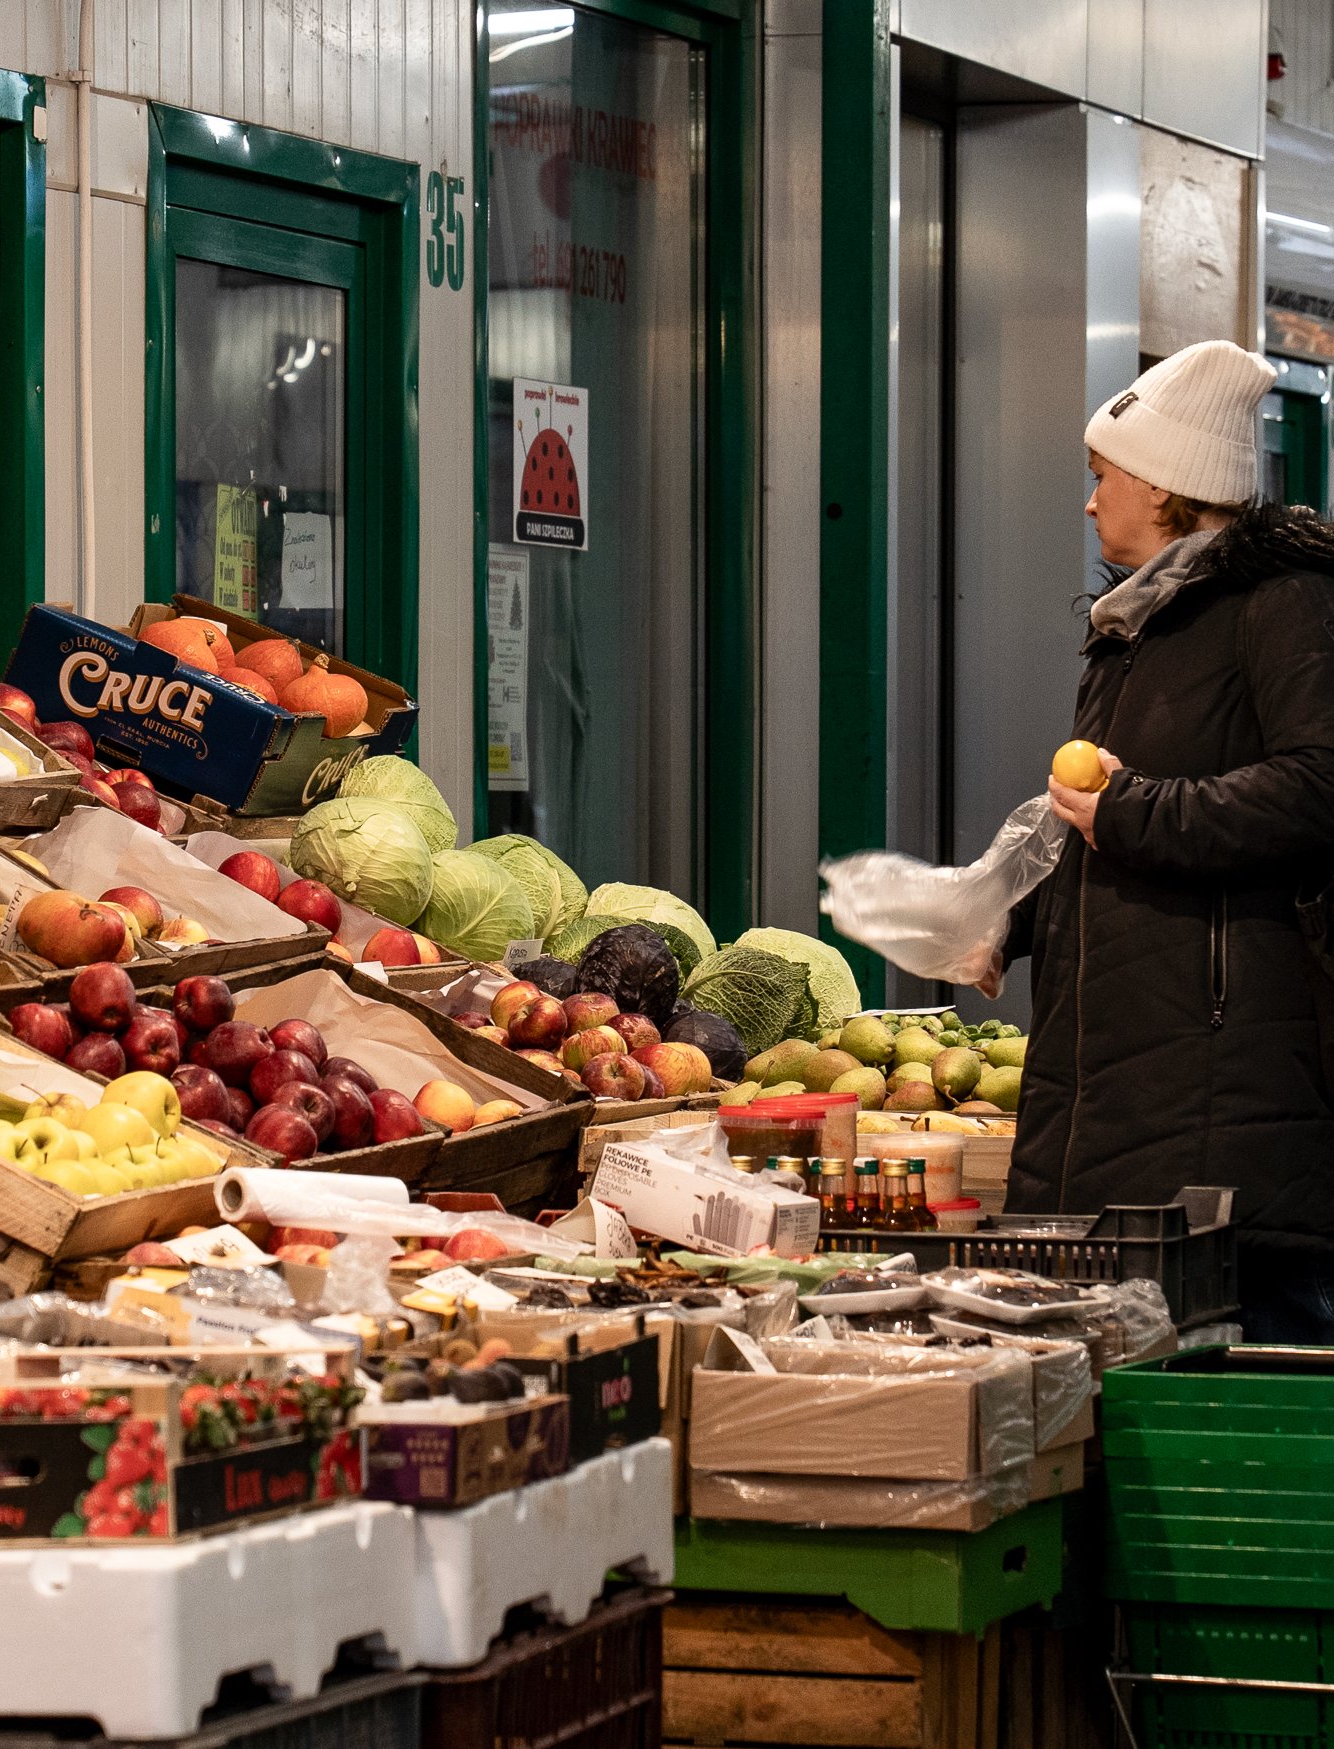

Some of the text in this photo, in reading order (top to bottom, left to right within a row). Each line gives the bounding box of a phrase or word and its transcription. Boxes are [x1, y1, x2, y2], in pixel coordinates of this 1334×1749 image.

[426, 171, 465, 292] 35
[526, 522, 575, 541] PANI SZPILECZKA
[76, 636, 120, 662] LEMONS
[59, 651, 215, 733] CRUCE
[142, 717, 198, 750] AUTHENTICS
[598, 1169, 628, 1186] GLOVES
[603, 1154, 654, 1178] FOLIOWE PE
[593, 1186, 611, 1199] BOX
[595, 1179, 633, 1196] PREMIUM
